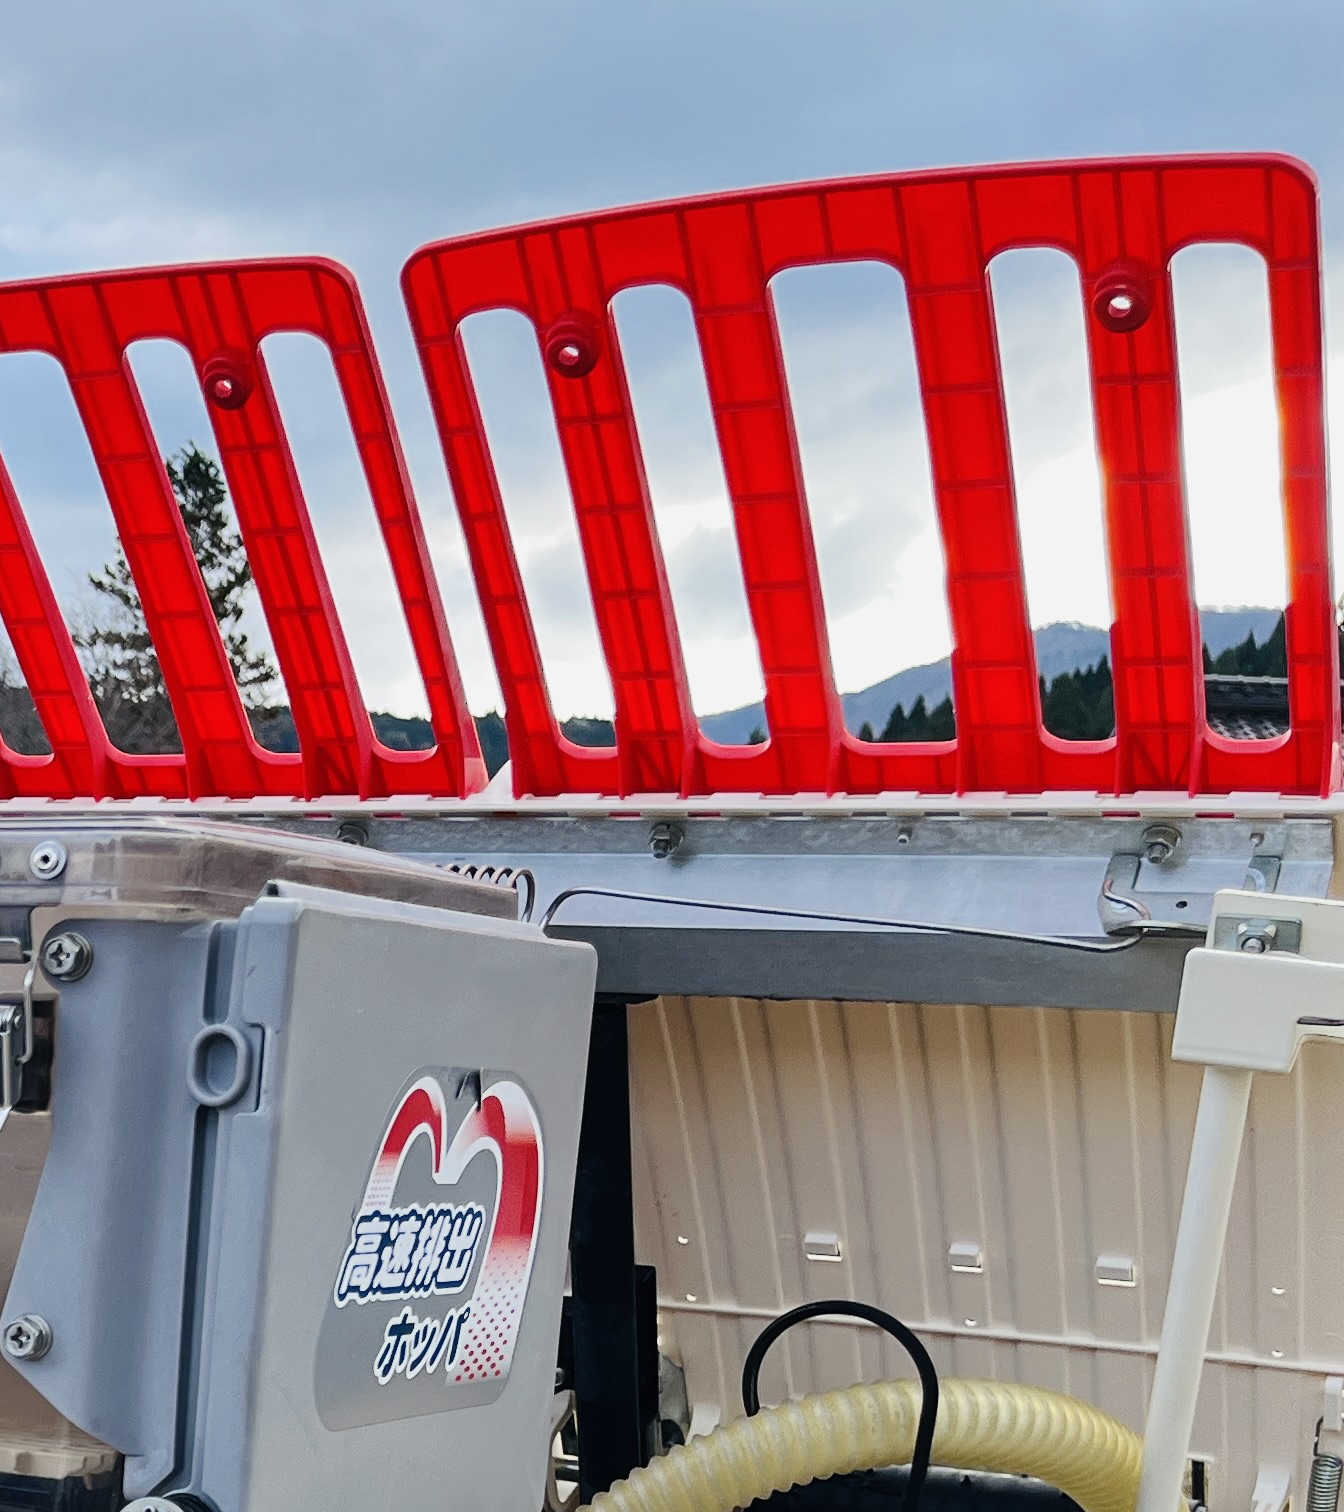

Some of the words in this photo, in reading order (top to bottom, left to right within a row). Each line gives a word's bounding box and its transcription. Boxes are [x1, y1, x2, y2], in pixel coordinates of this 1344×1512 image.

[338, 1208, 483, 1302] 高速排出
[378, 1309, 470, 1378] ホッパ
